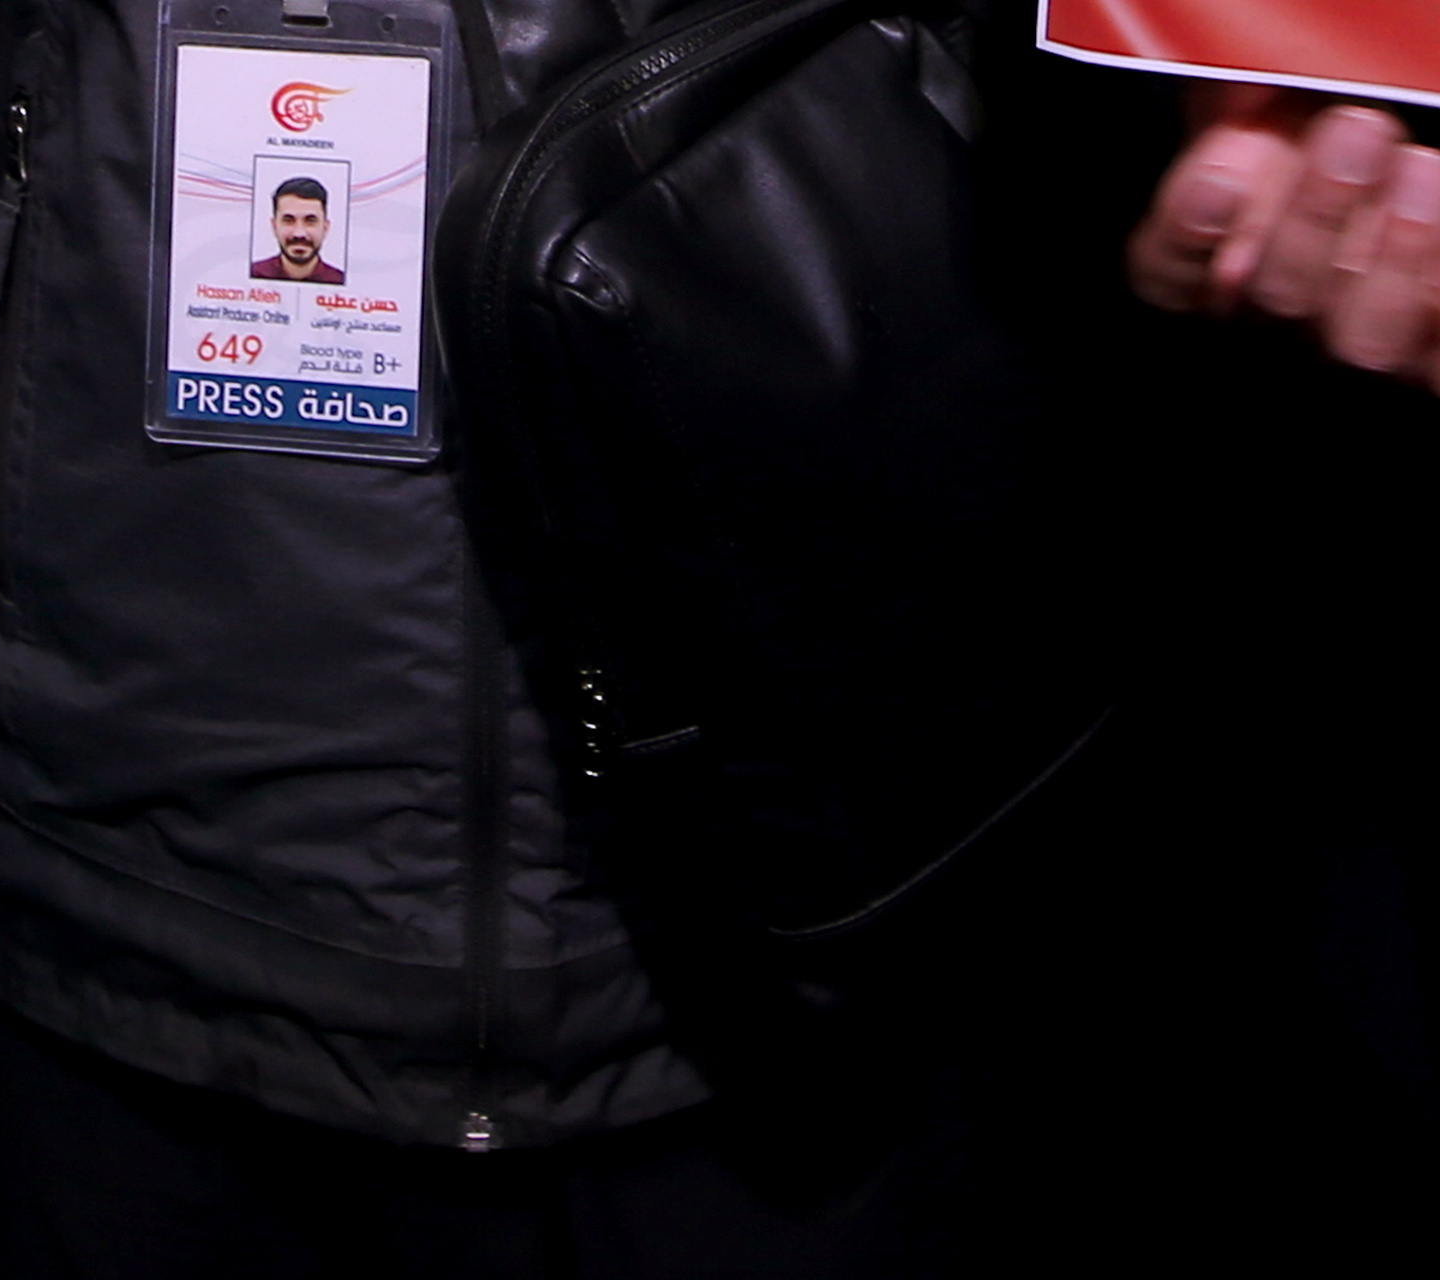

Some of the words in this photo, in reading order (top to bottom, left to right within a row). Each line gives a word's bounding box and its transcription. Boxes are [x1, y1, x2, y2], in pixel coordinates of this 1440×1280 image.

[196, 284, 245, 302] Hassan
[360, 297, 399, 314] حسن
[197, 332, 263, 365] 649
[300, 343, 334, 357] Blood
[374, 353, 403, 375] B+
[176, 378, 285, 419] PRESS
[297, 387, 410, 428] صحافة
